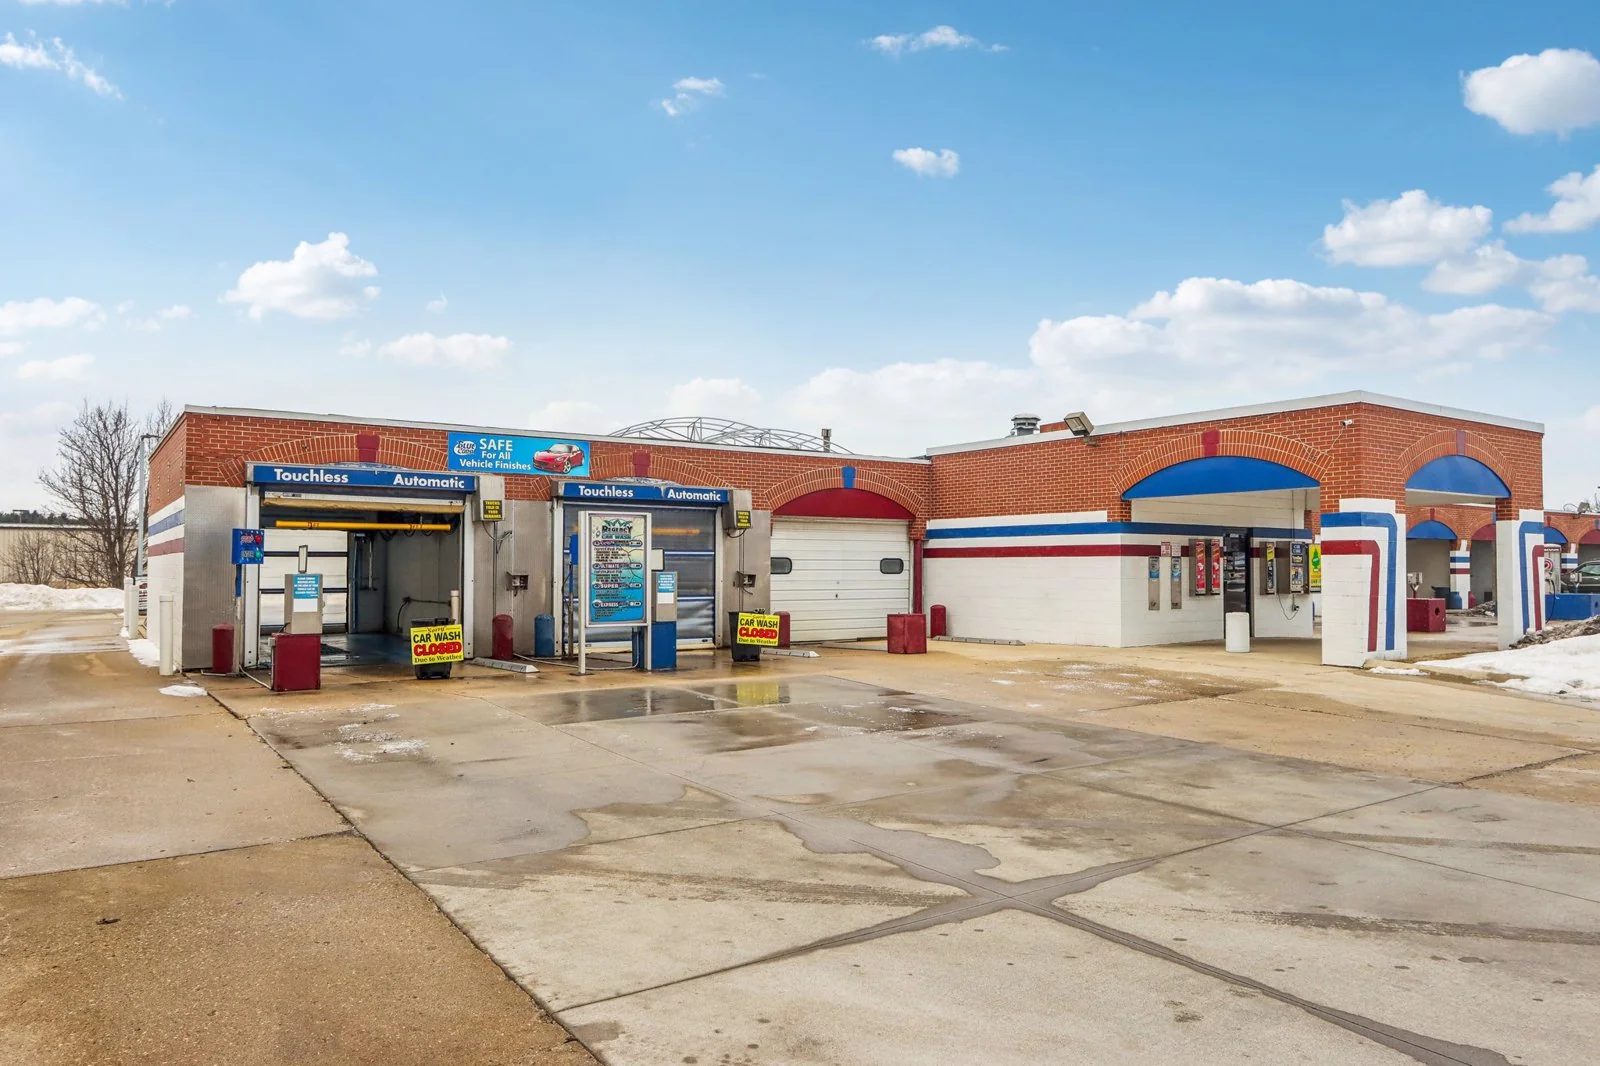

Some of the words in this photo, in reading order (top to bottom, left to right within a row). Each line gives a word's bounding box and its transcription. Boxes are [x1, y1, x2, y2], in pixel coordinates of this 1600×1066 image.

[480, 438, 514, 451] SAFE
[482, 450, 496, 459] For
[499, 451, 511, 460] All
[460, 458, 493, 469] Vehicle
[495, 460, 532, 471] Finishes
[274, 469, 349, 484] Touchless
[393, 474, 465, 489] Automatic
[579, 485, 634, 498] Touchless
[668, 489, 721, 501] Automatic
[602, 525, 632, 533] REGENCY
[740, 618, 754, 627] CAR
[757, 619, 778, 629] WASH
[413, 633, 432, 643] CAR
[434, 631, 461, 642] WASH
[739, 626, 778, 640] CLOSED
[414, 641, 462, 657] CLOSED
